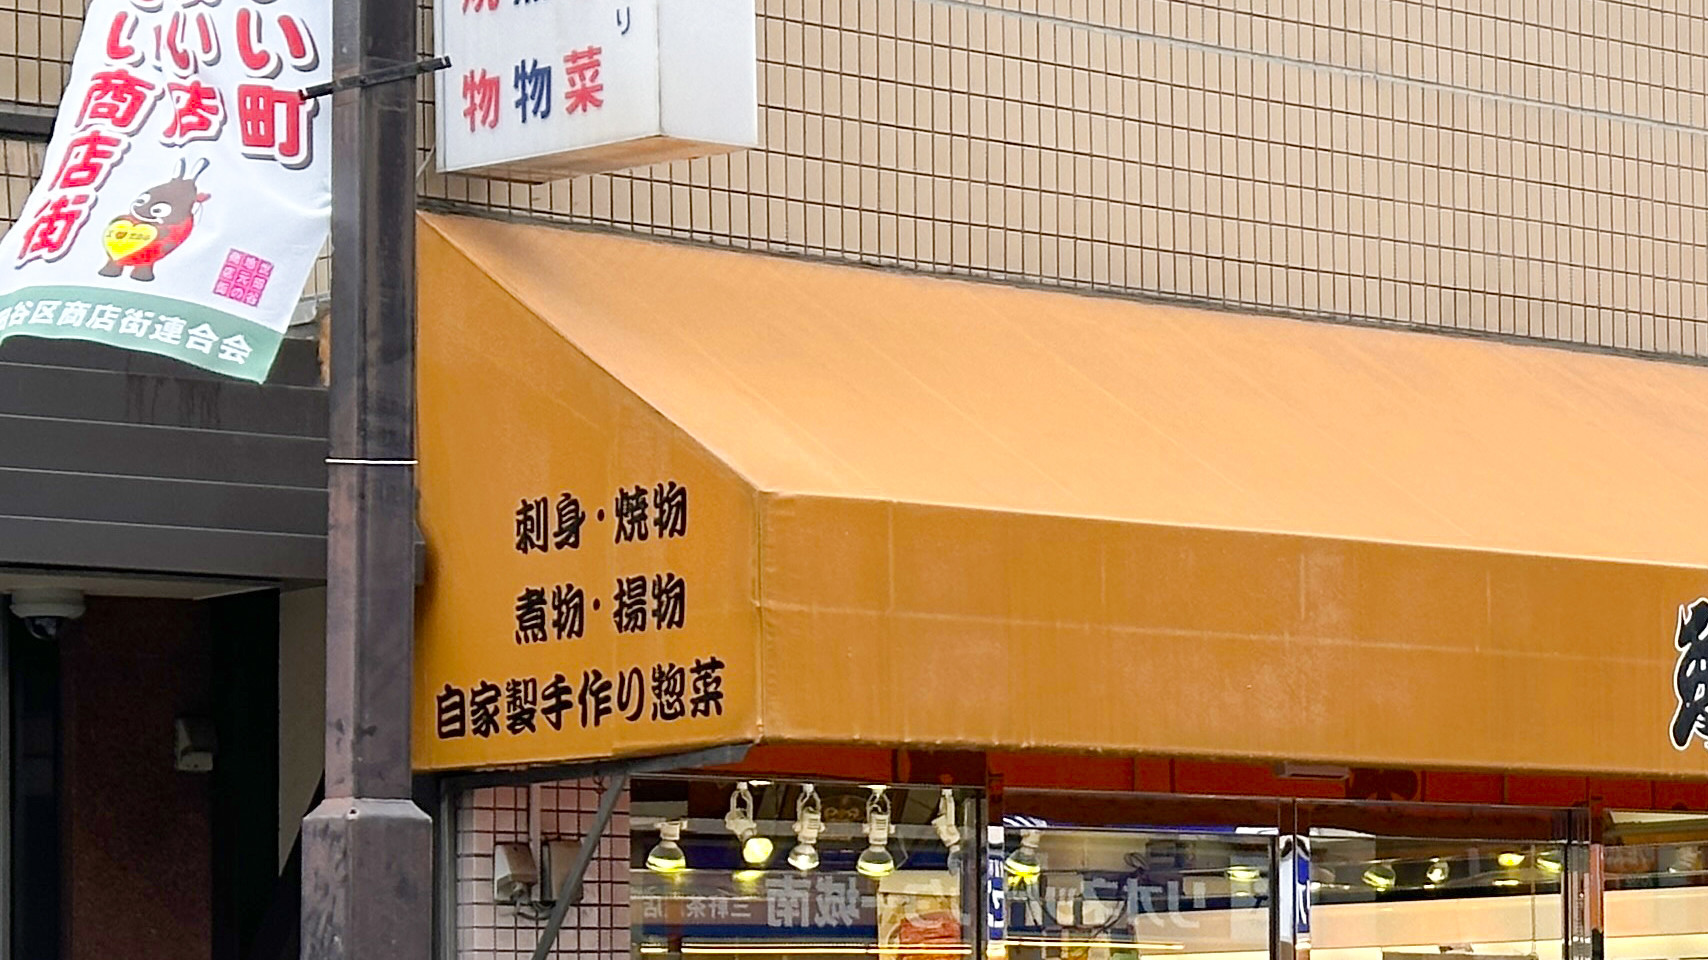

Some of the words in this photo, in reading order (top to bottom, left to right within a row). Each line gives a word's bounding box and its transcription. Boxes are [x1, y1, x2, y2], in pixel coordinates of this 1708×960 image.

[163, 0, 220, 138] い店
[237, 0, 307, 157] い町
[462, 0, 501, 132] 物
[513, 0, 552, 124] 物
[563, 45, 604, 115] 菜
[18, 0, 160, 260] い商店街
[435, 656, 725, 739] 自家製手作り惣菜
